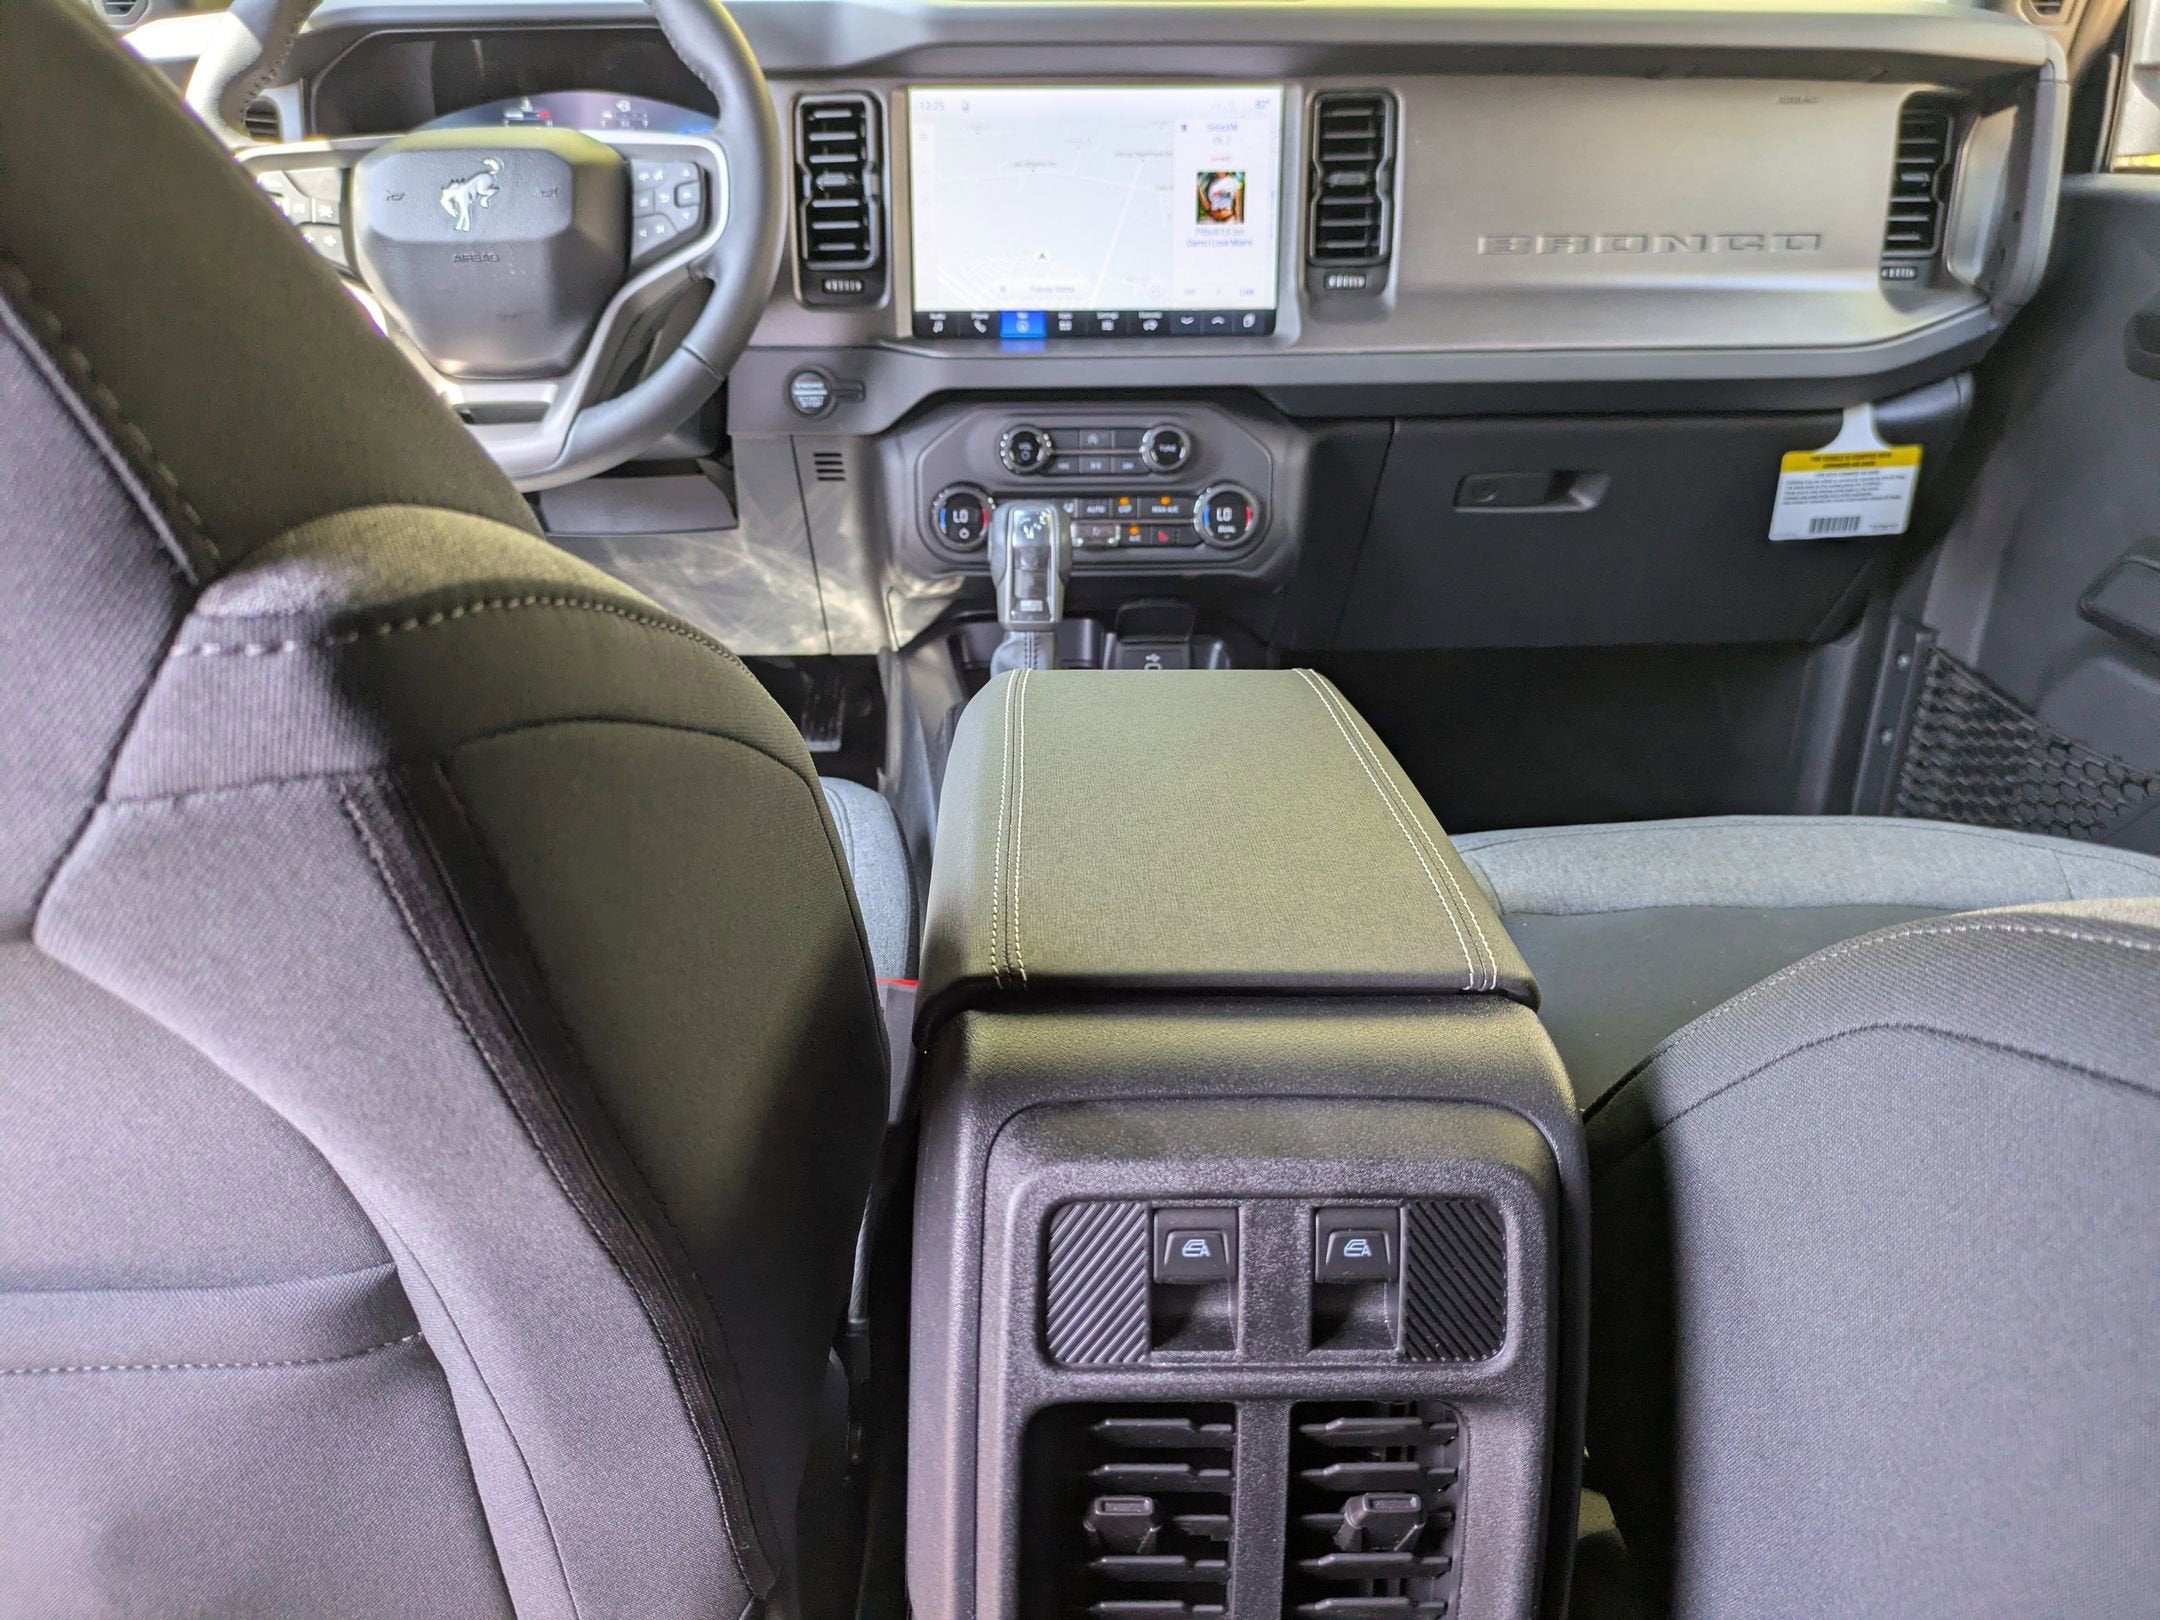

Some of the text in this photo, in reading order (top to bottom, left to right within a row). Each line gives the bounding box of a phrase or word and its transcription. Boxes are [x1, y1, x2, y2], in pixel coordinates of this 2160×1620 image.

[1477, 233, 1821, 255] BRONCO
[953, 508, 969, 523] LO
[1216, 506, 1232, 522] LO
